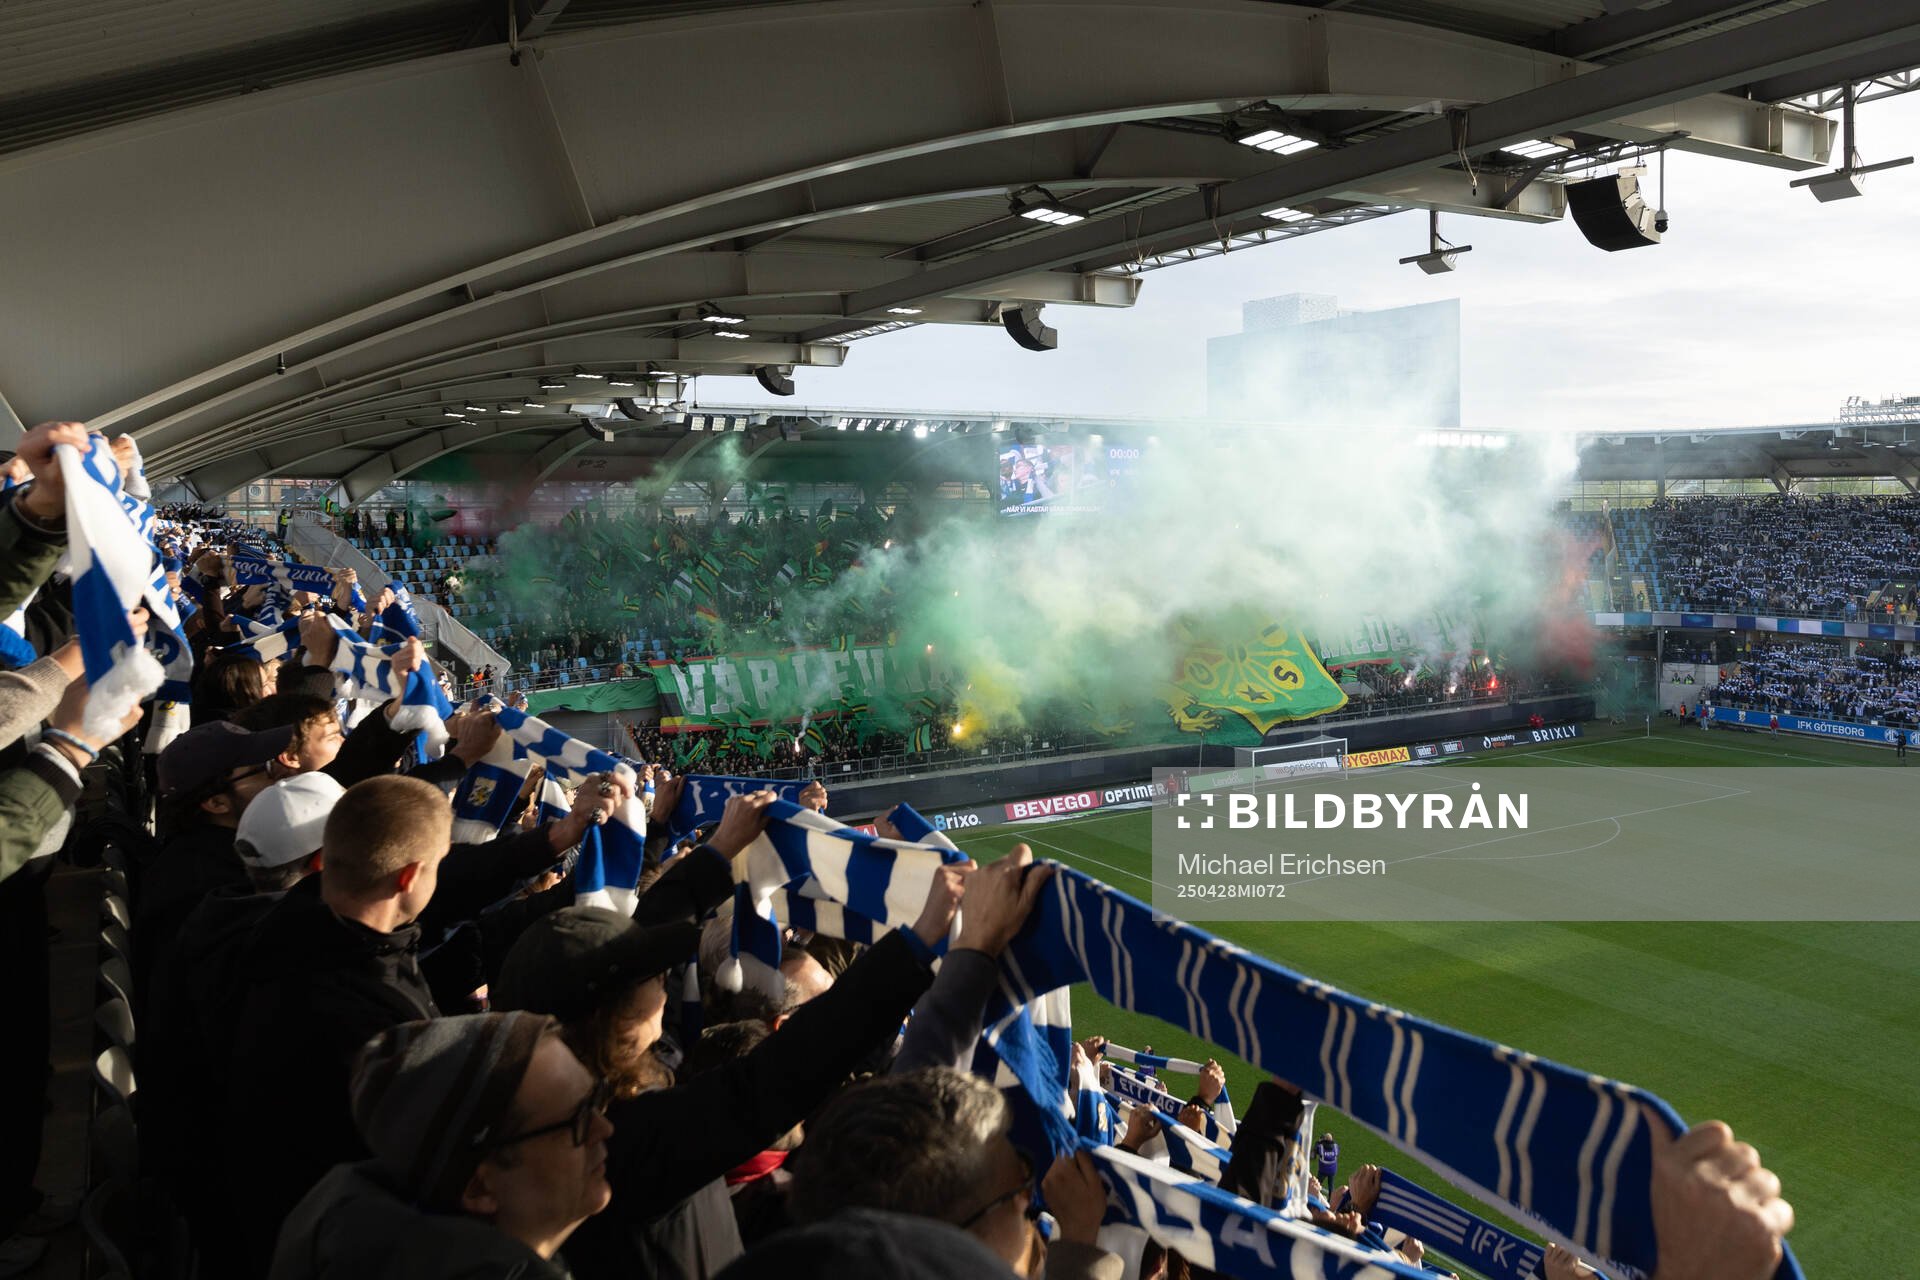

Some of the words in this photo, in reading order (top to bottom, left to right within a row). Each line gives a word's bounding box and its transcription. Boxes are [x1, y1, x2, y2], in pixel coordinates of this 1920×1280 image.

[671, 655, 780, 716] VÅR
[1532, 725, 1577, 743] BRIXLY
[1797, 720, 1812, 731] IFK
[1813, 722, 1865, 737] GÖTEBORG
[1342, 749, 1408, 769] BYGGMAX
[1104, 783, 1168, 804] OPTIMER
[1013, 793, 1091, 819] BEVEGO
[1119, 1075, 1144, 1099] ETT
[1471, 1224, 1516, 1269] IFK
